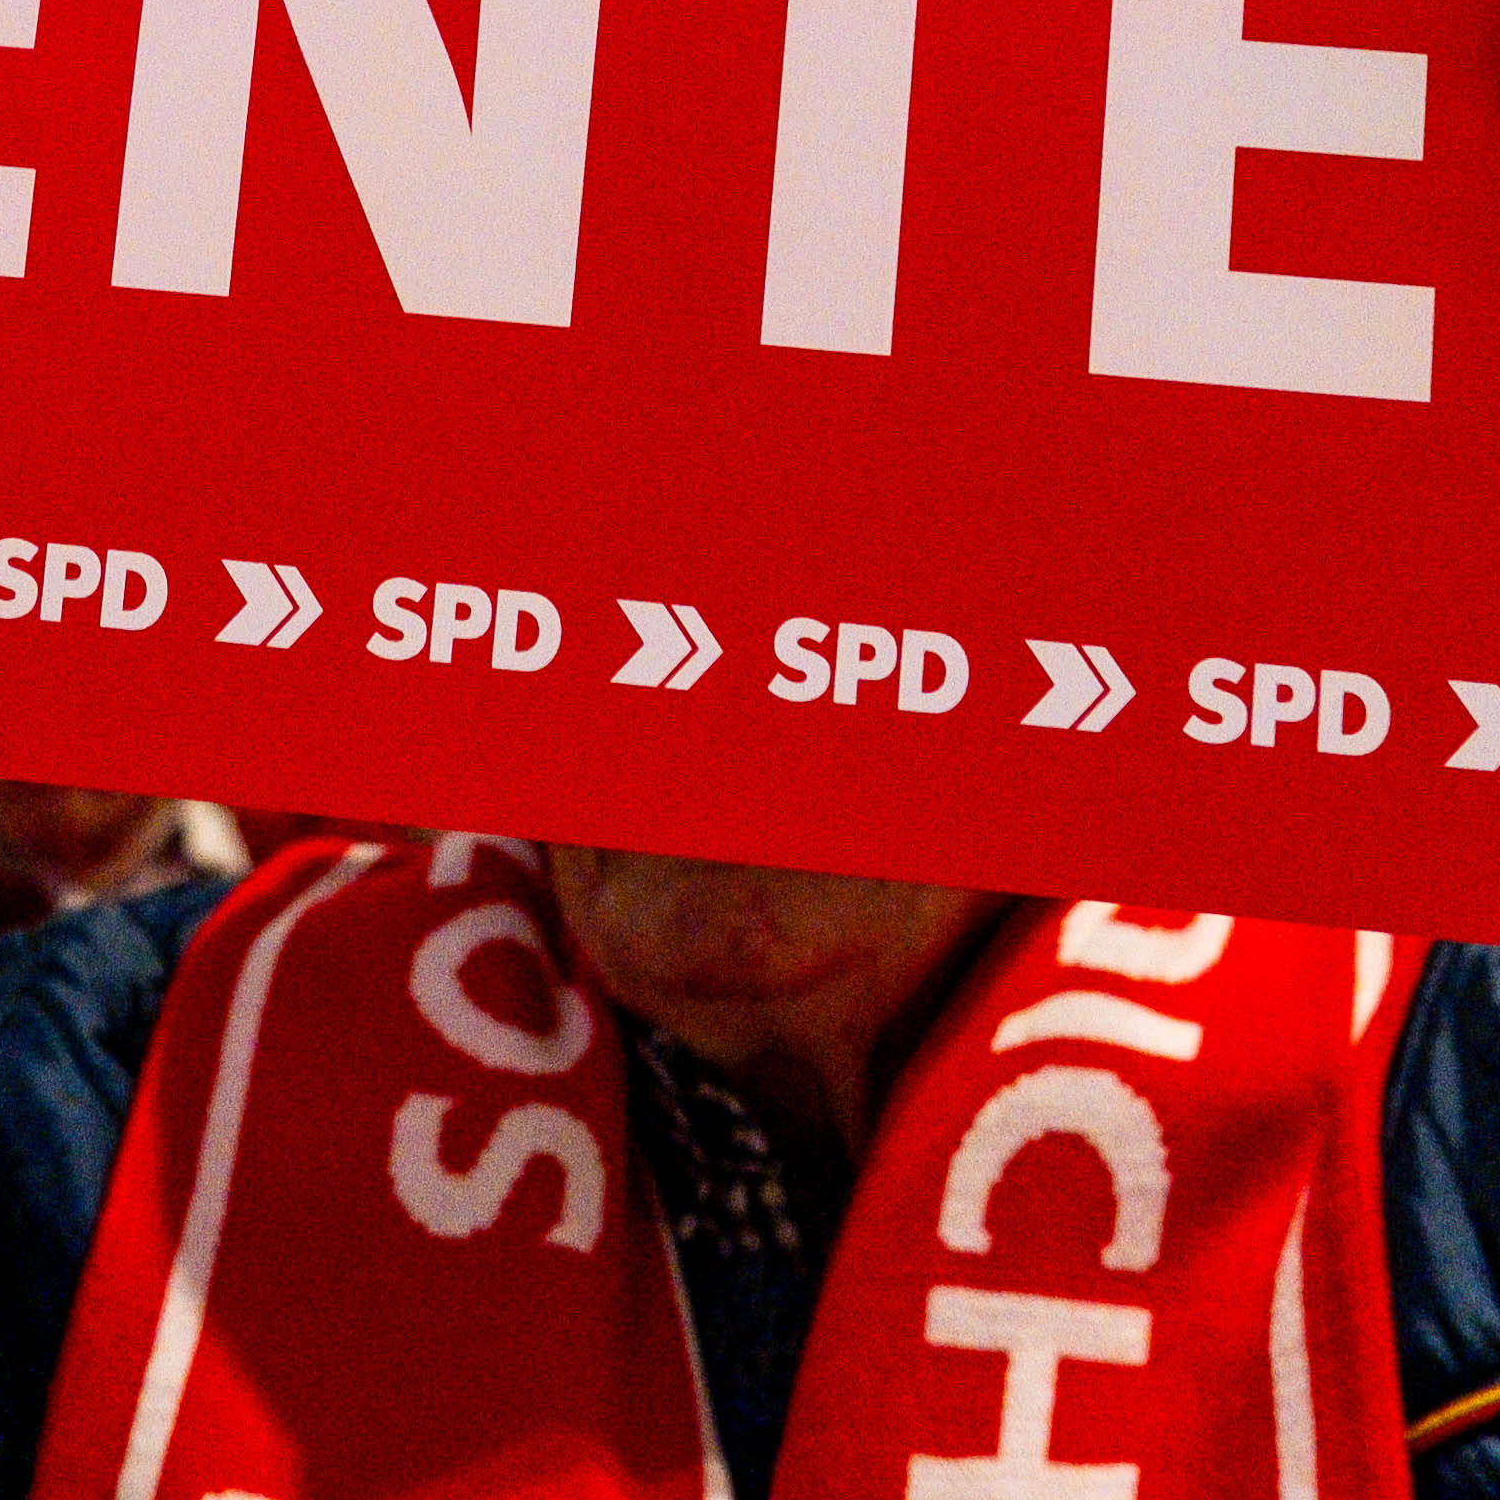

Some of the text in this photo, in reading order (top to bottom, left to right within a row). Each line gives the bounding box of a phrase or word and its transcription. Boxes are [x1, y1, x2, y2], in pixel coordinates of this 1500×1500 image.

[365, 577, 563, 672] SPD
[767, 617, 969, 715] SPD
[1182, 657, 1392, 757] SPD
